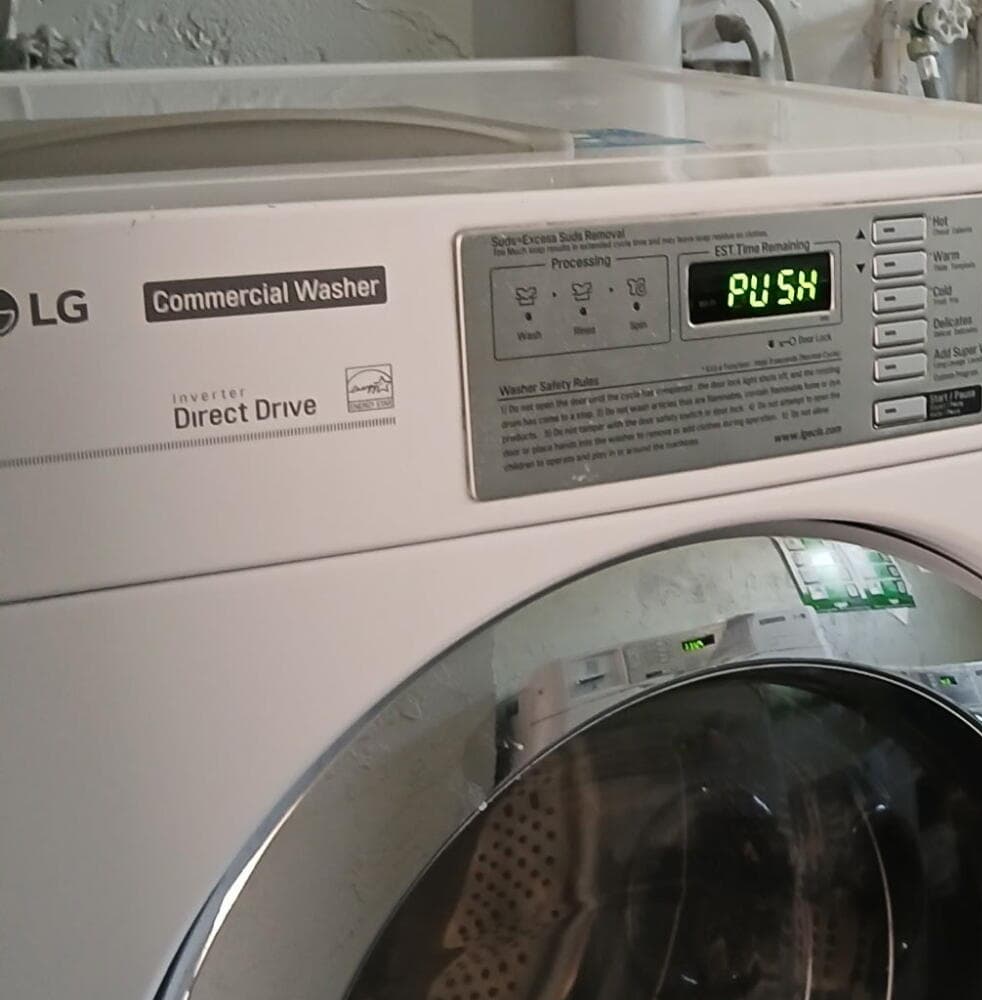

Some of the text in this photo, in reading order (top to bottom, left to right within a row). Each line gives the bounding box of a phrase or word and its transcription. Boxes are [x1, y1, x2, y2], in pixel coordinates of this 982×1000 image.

[933, 216, 948, 227] Hot
[714, 244, 733, 258] EST
[735, 242, 760, 256] Time
[761, 238, 811, 254] Remaining
[933, 250, 960, 262] Warm
[551, 255, 612, 270] Processing
[152, 274, 381, 315] Commercial Washer
[727, 268, 818, 309] PUSH
[933, 285, 952, 297] Cold
[29, 290, 90, 326] LG
[934, 347, 951, 359] Add
[952, 345, 977, 358] Super
[499, 381, 538, 397] Washer
[539, 377, 571, 393] Safety
[174, 397, 318, 430] Direct Drive
